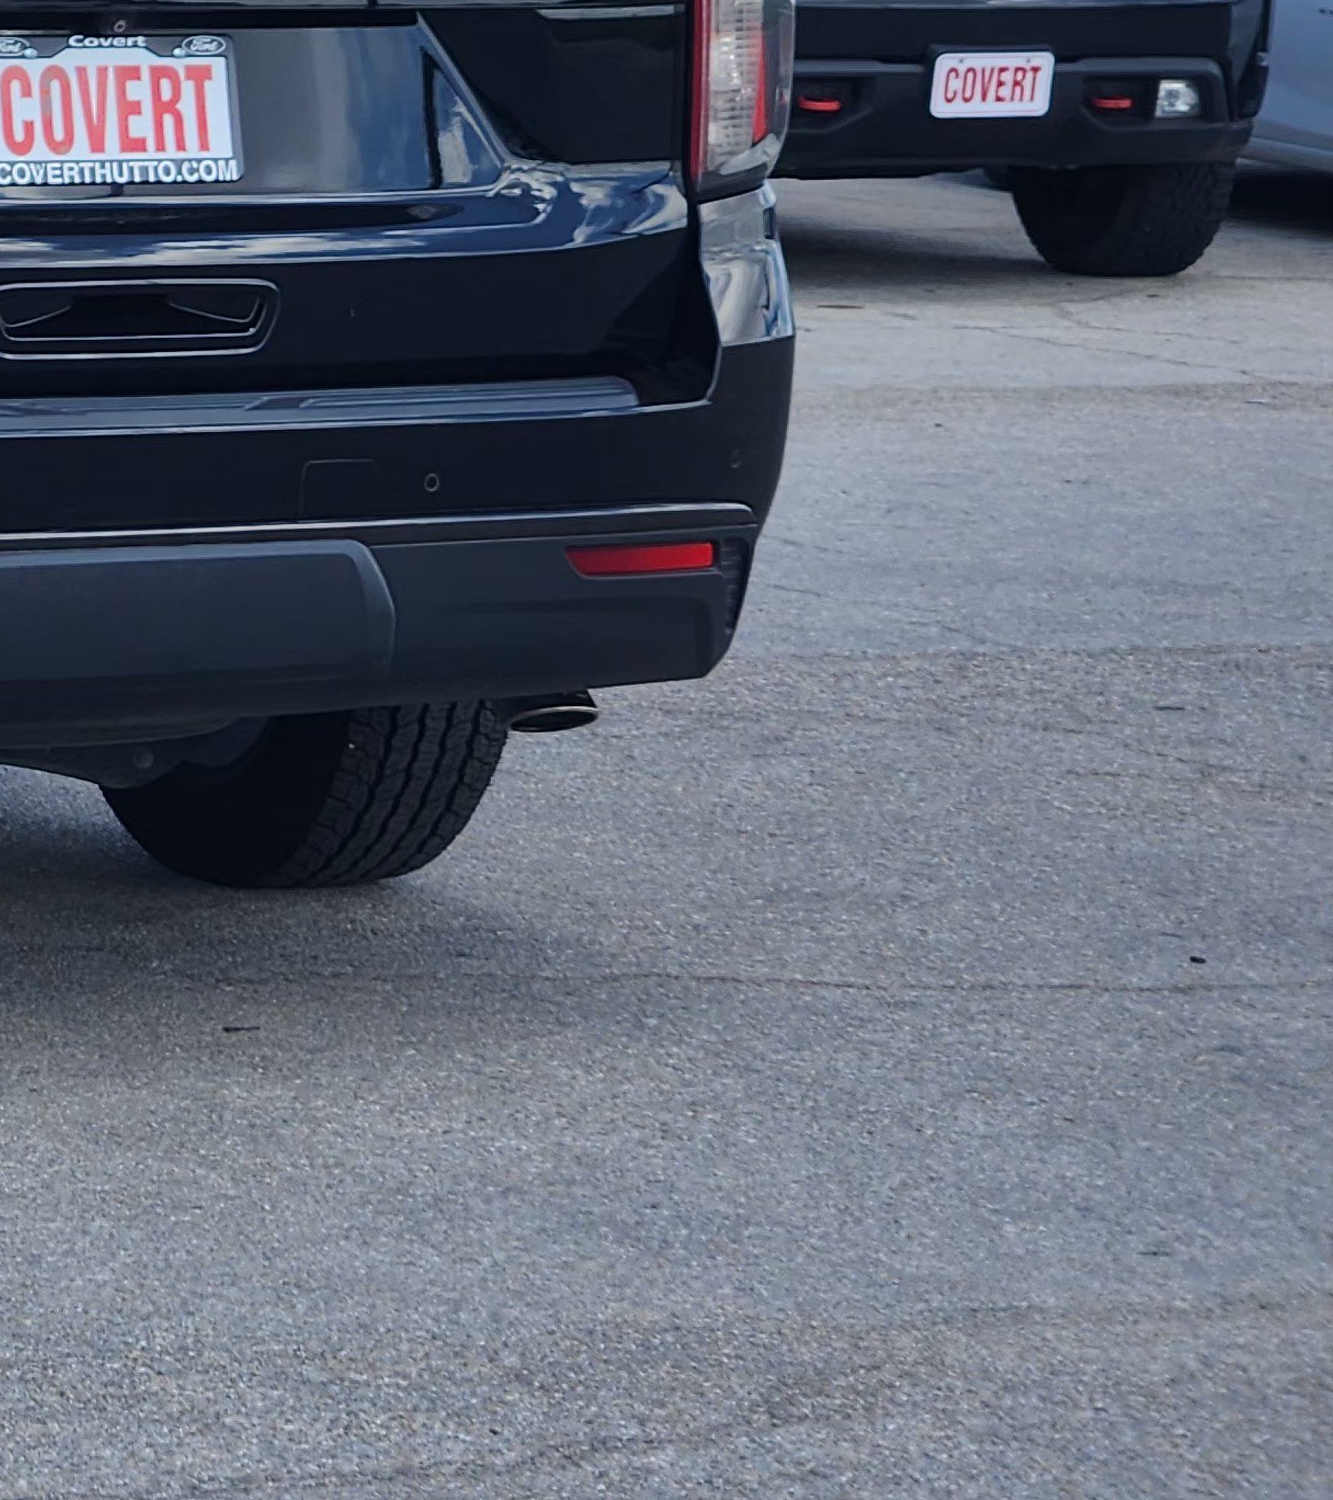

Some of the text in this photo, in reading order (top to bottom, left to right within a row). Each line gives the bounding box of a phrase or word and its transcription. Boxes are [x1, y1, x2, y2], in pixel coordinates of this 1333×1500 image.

[68, 35, 147, 47] Covert
[191, 36, 219, 52] Ford
[944, 65, 1042, 104] COVERT
[0, 64, 213, 156] COVERT
